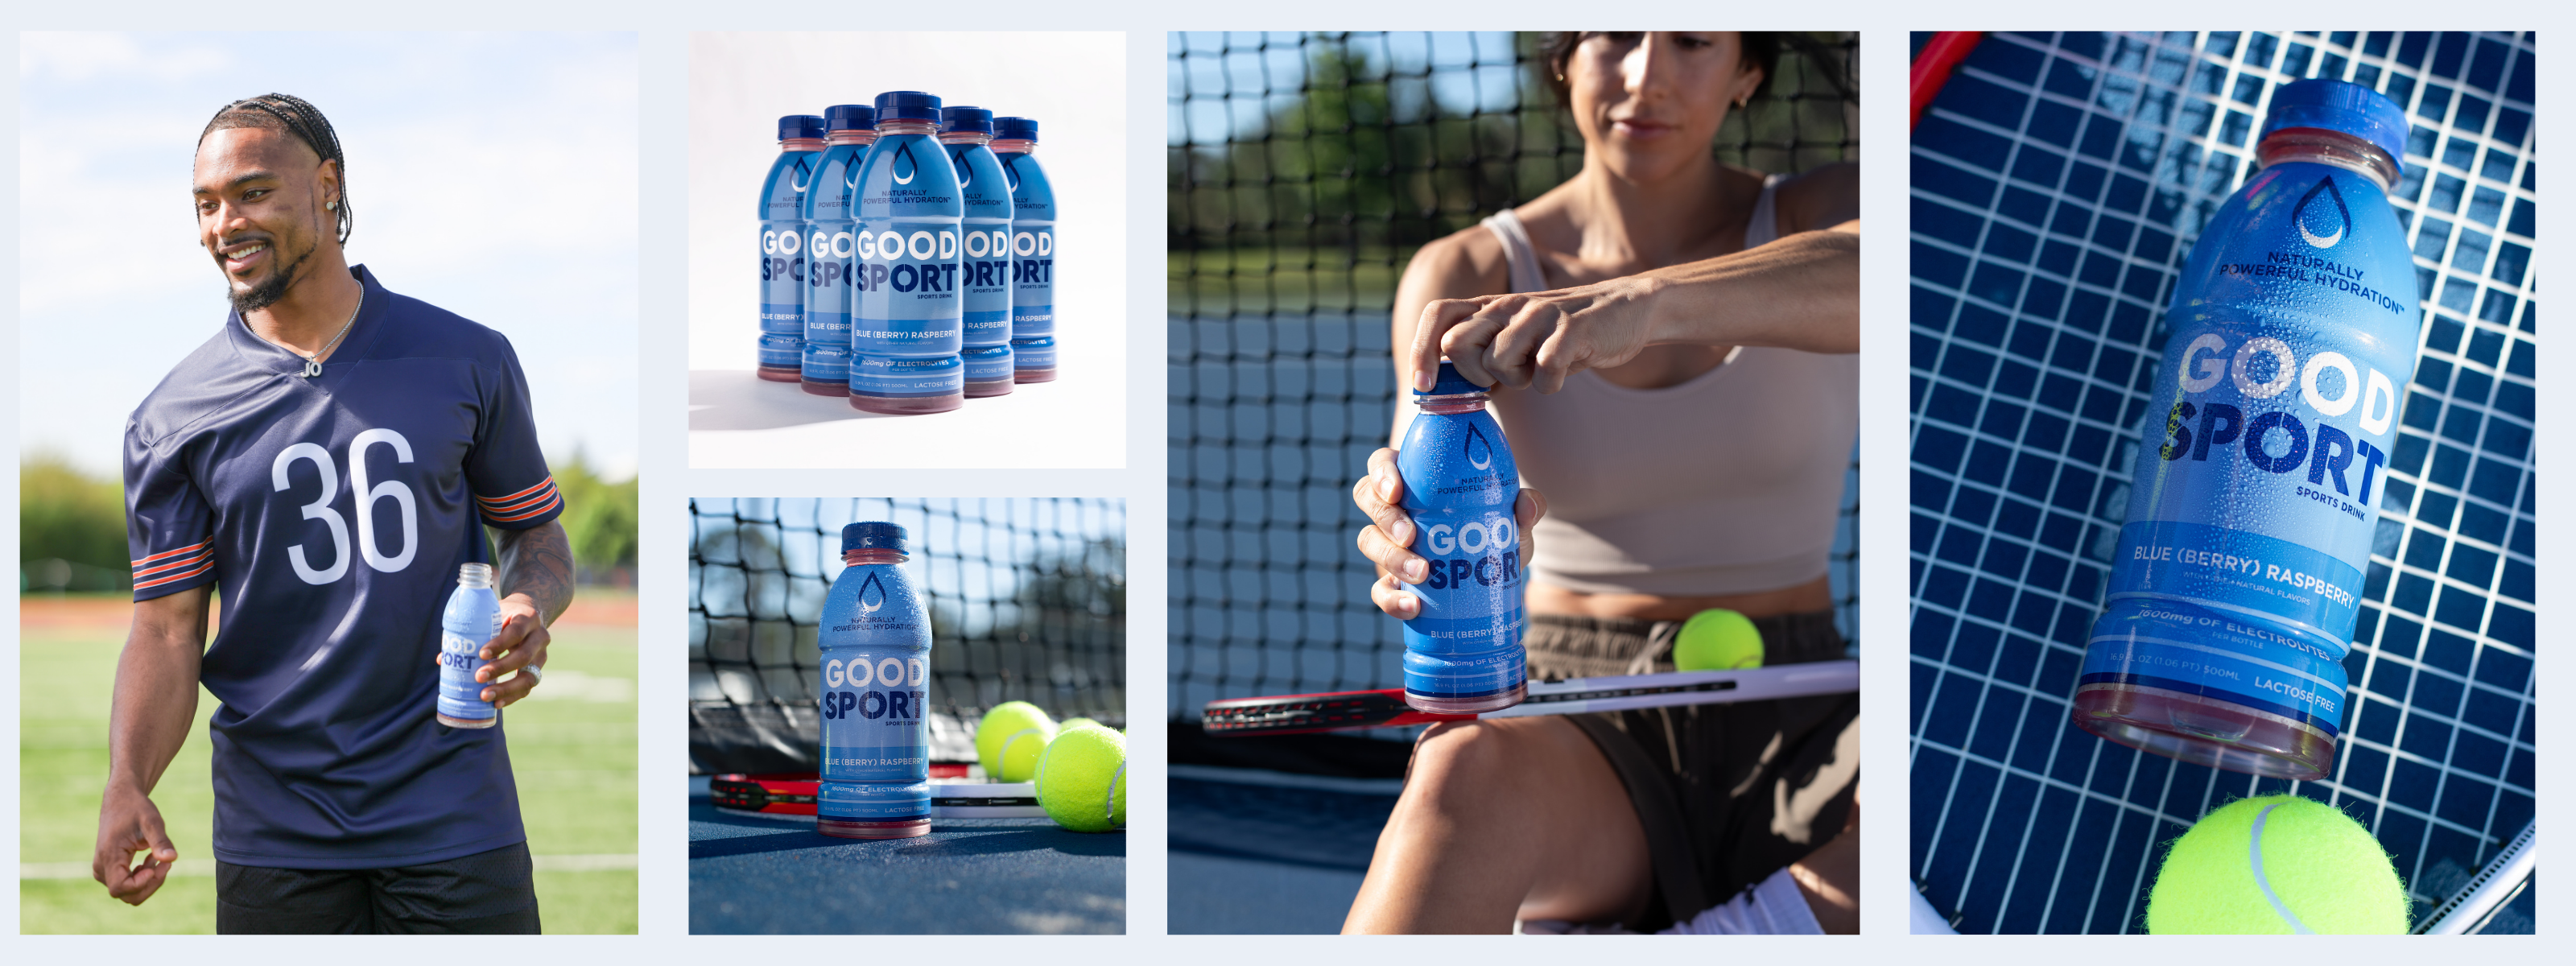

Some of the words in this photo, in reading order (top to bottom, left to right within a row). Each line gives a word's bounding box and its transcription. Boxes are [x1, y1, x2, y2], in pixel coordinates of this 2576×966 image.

[857, 230, 956, 260] GOOD
[857, 263, 957, 292] SPORT
[2219, 263, 2308, 283] POWERFUL
[2267, 251, 2363, 282] NATURALLY
[856, 329, 871, 338] BLUE
[873, 331, 909, 339] (BERRY)
[911, 329, 956, 338] RASPBERRY
[968, 320, 1008, 328] RASPBERRY
[300, 361, 322, 378] JO
[2178, 333, 2395, 436] GOOD
[1438, 485, 1485, 494] POWERFUL
[2296, 485, 2339, 508] SPORTS
[2341, 502, 2365, 522] DRINK
[272, 428, 418, 585] 36
[2134, 546, 2172, 561] BLUE
[2178, 547, 2260, 576] (BERRY)
[2266, 564, 2355, 609] RASPBERRY
[2236, 580, 2276, 596] NATURAL
[2277, 590, 2310, 605] FLAVORS
[833, 624, 871, 632] POWERFUL
[1431, 630, 1454, 638] BLUE
[2139, 609, 2194, 625] 1600mg
[2198, 617, 2222, 627] OF
[2226, 622, 2330, 661] ELECTROLYTES
[2212, 631, 2229, 641] PER
[2231, 636, 2264, 650] BOTTLE
[826, 658, 924, 687] GOOD
[2110, 653, 2124, 661] 16.9
[2138, 654, 2153, 663] OZ
[2154, 656, 2178, 667] (1.06
[2182, 661, 2200, 672] PT)
[2203, 664, 2241, 681] 500ML
[2255, 676, 2312, 704] LACTOSE
[2314, 695, 2335, 713] FREE
[825, 691, 926, 719] SPORT
[841, 758, 877, 766] (BERRY)
[880, 758, 923, 766] RASPBERRY
